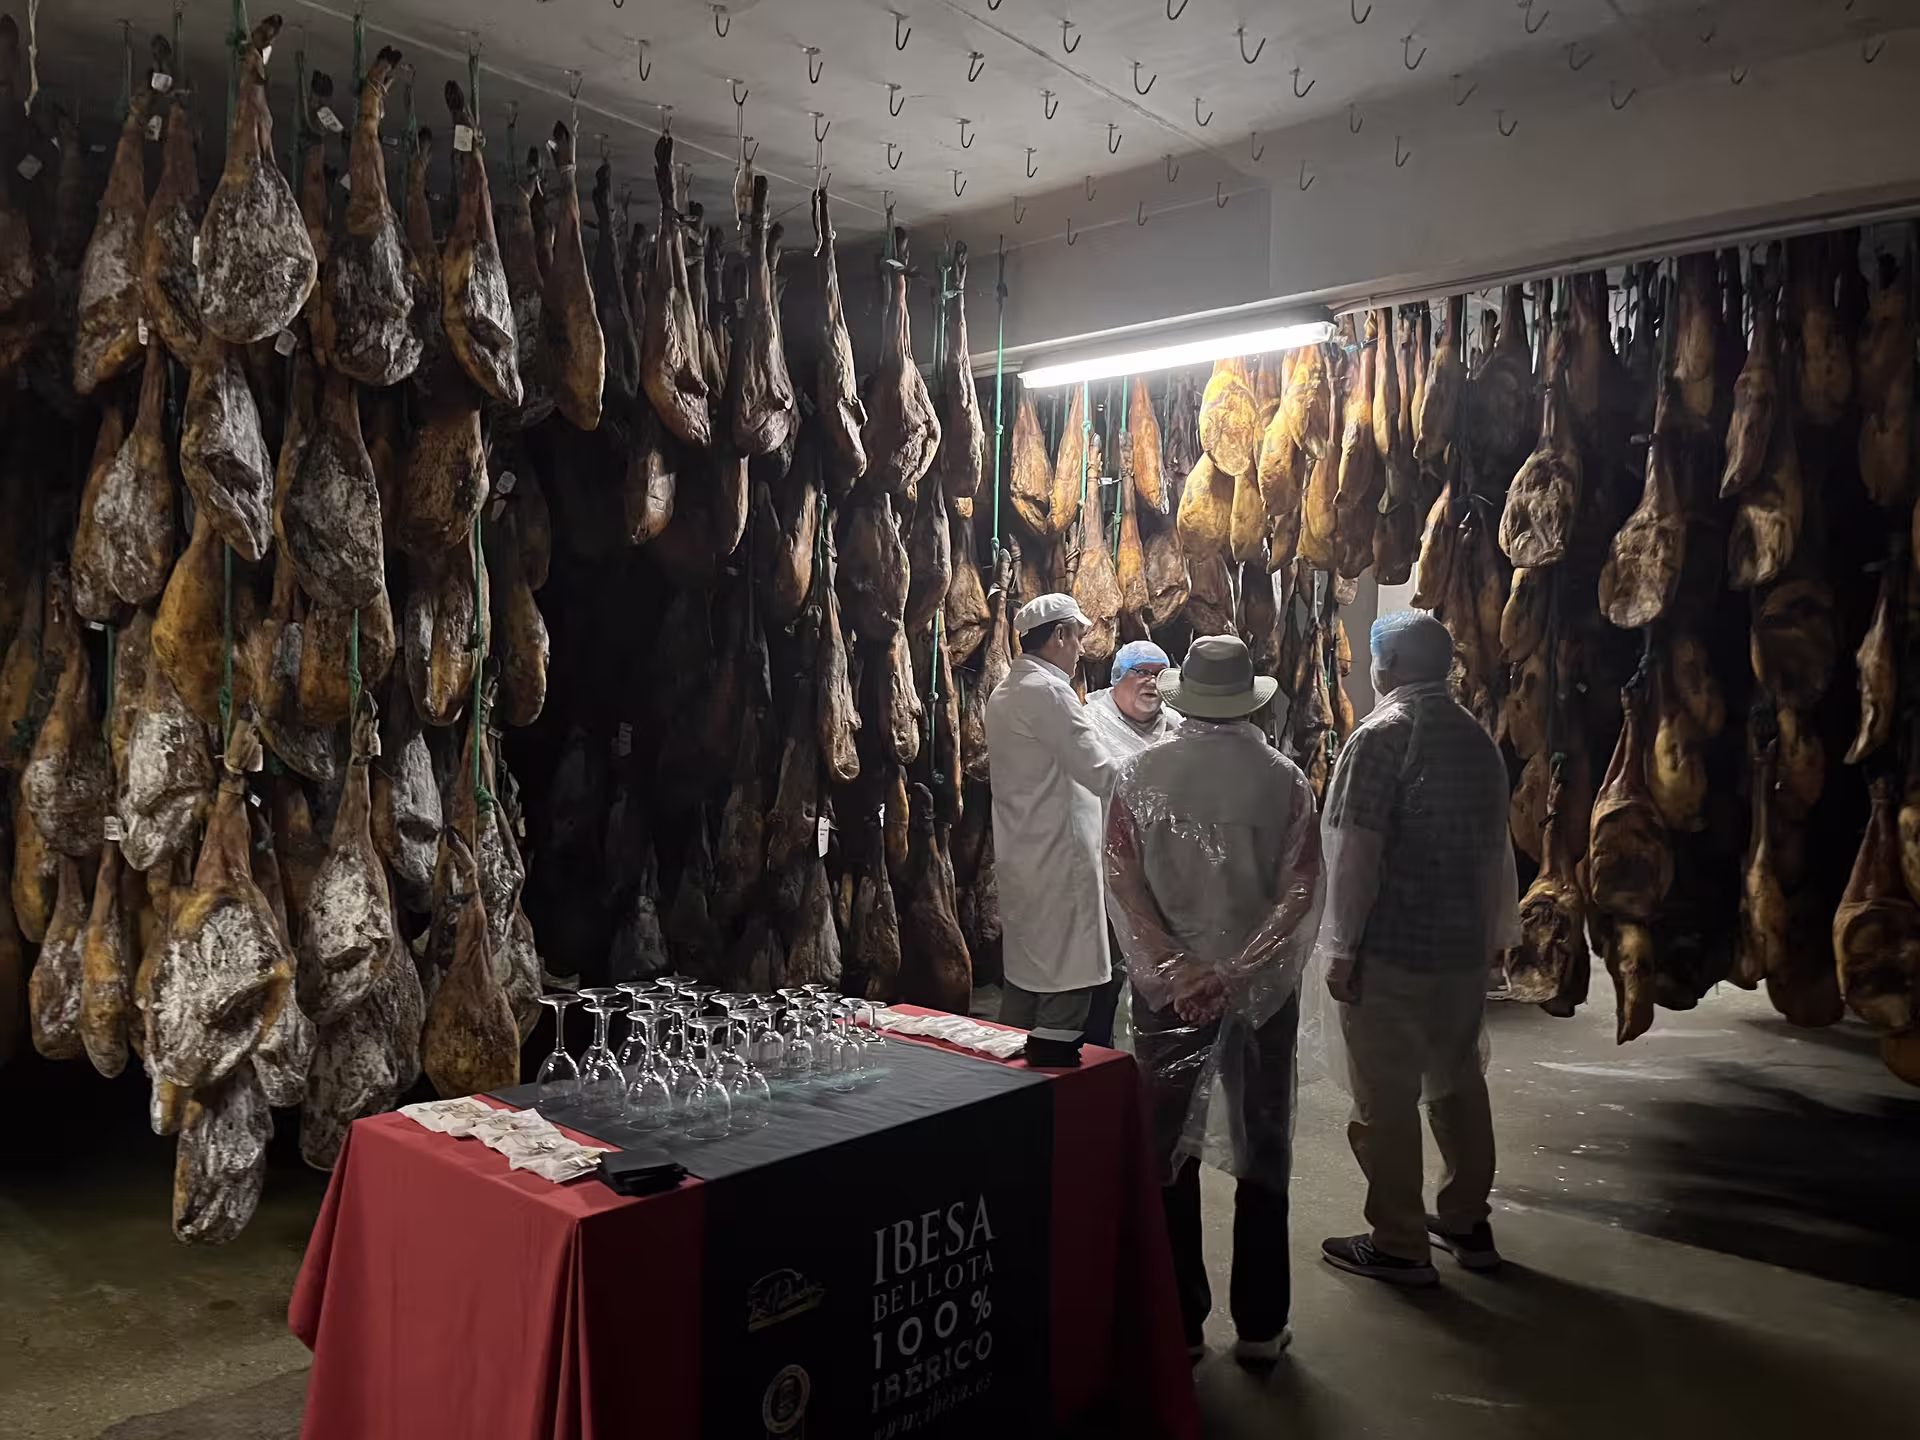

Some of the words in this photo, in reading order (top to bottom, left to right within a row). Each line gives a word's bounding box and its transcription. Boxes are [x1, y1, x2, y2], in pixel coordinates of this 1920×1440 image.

[873, 1193, 996, 1286] IBESA
[873, 1249, 993, 1322] BELLOTA
[872, 1331, 992, 1413] IBÉRICO
